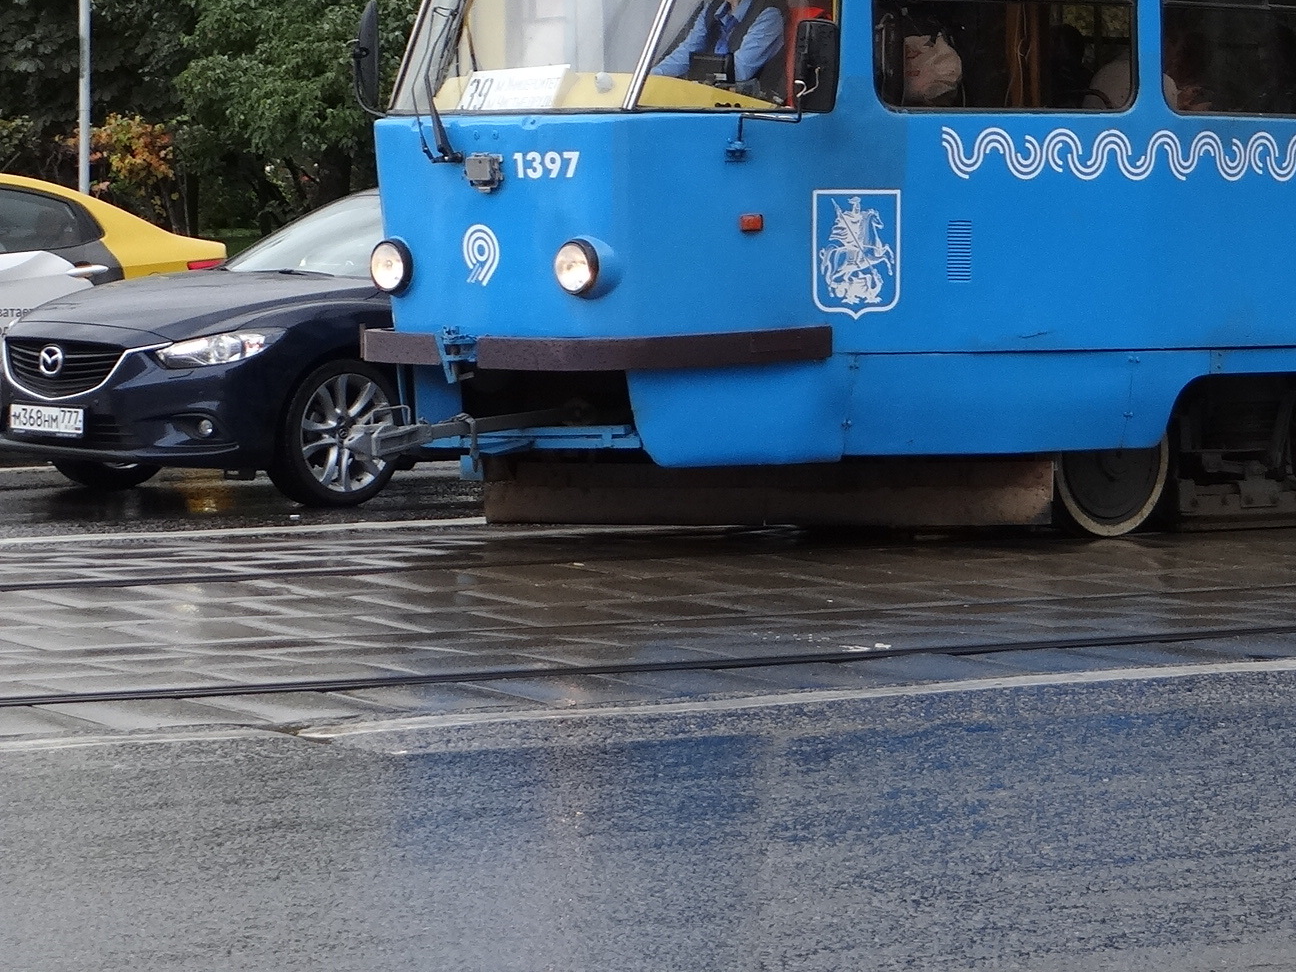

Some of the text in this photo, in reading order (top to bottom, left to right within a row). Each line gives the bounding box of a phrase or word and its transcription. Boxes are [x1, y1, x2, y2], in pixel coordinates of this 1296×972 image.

[461, 78, 494, 110] 39
[513, 151, 580, 179] 1397
[60, 410, 79, 424] 777
